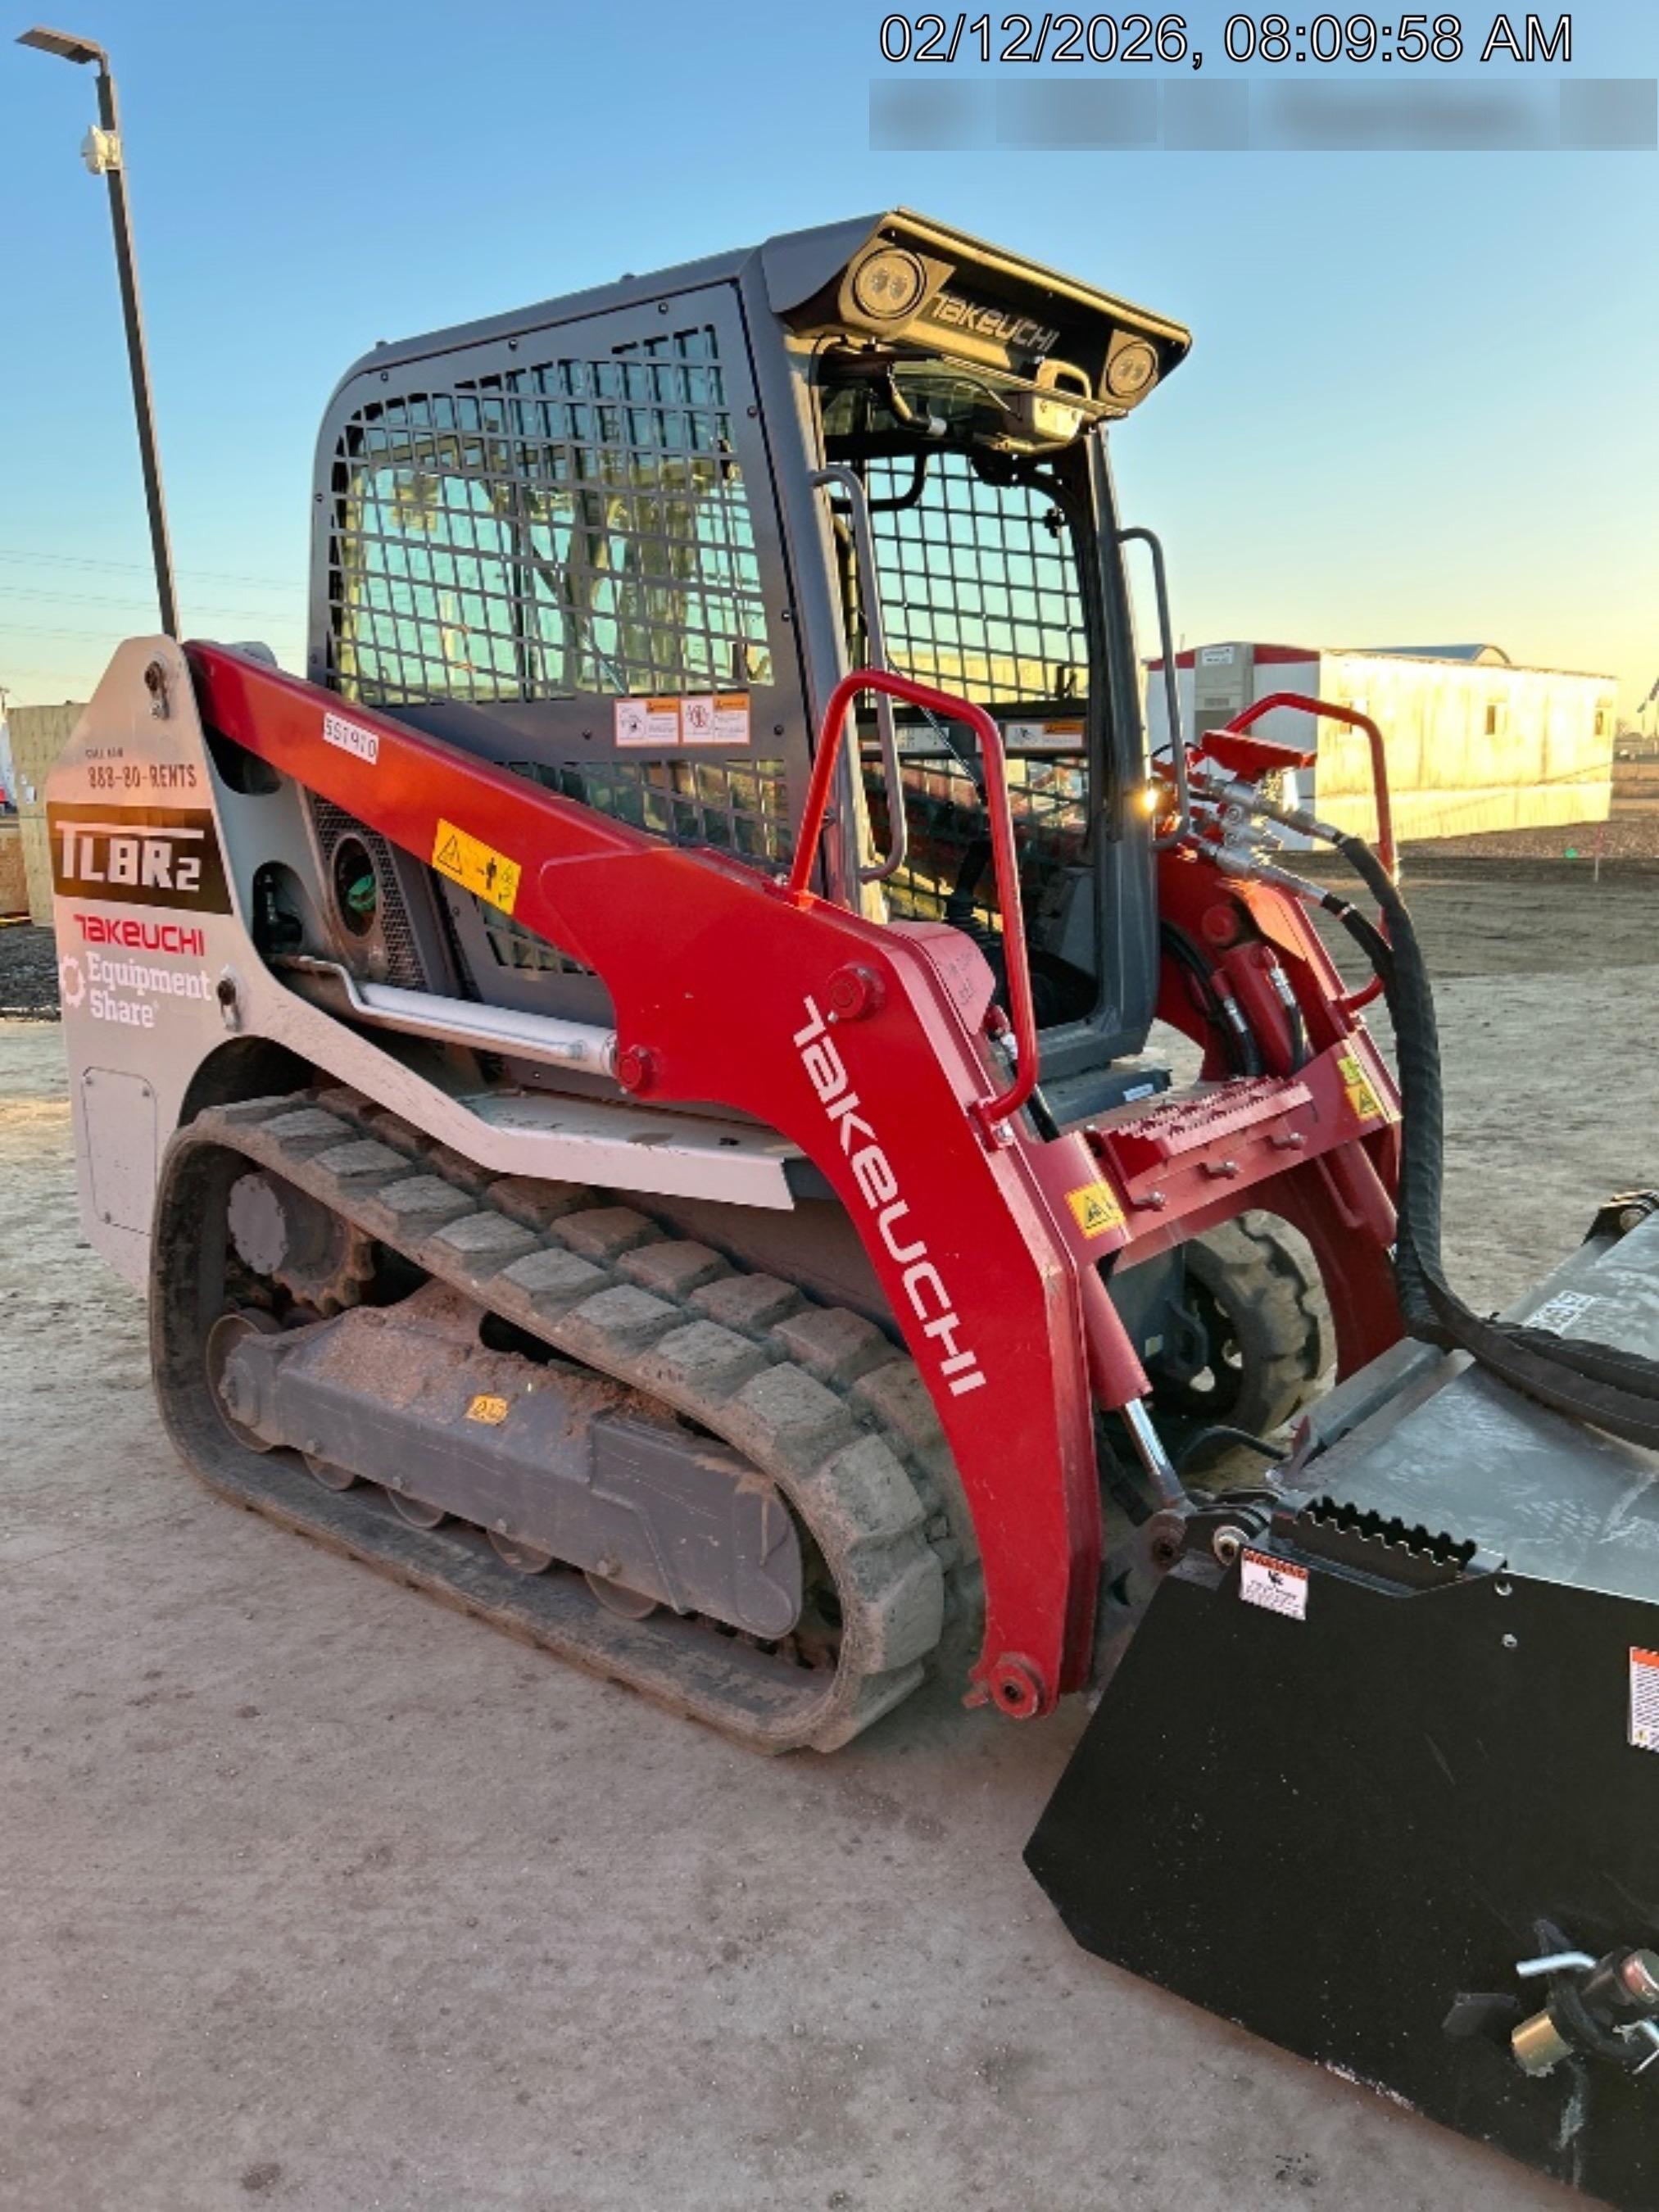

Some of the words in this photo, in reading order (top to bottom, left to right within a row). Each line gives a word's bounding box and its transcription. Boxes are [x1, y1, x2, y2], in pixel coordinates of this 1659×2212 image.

[931, 292, 1060, 352] TAKEUCHI
[73, 914, 205, 956] TAKEUCHI
[85, 951, 211, 1000] Equipment
[792, 995, 986, 1397] TAKEUCHI
